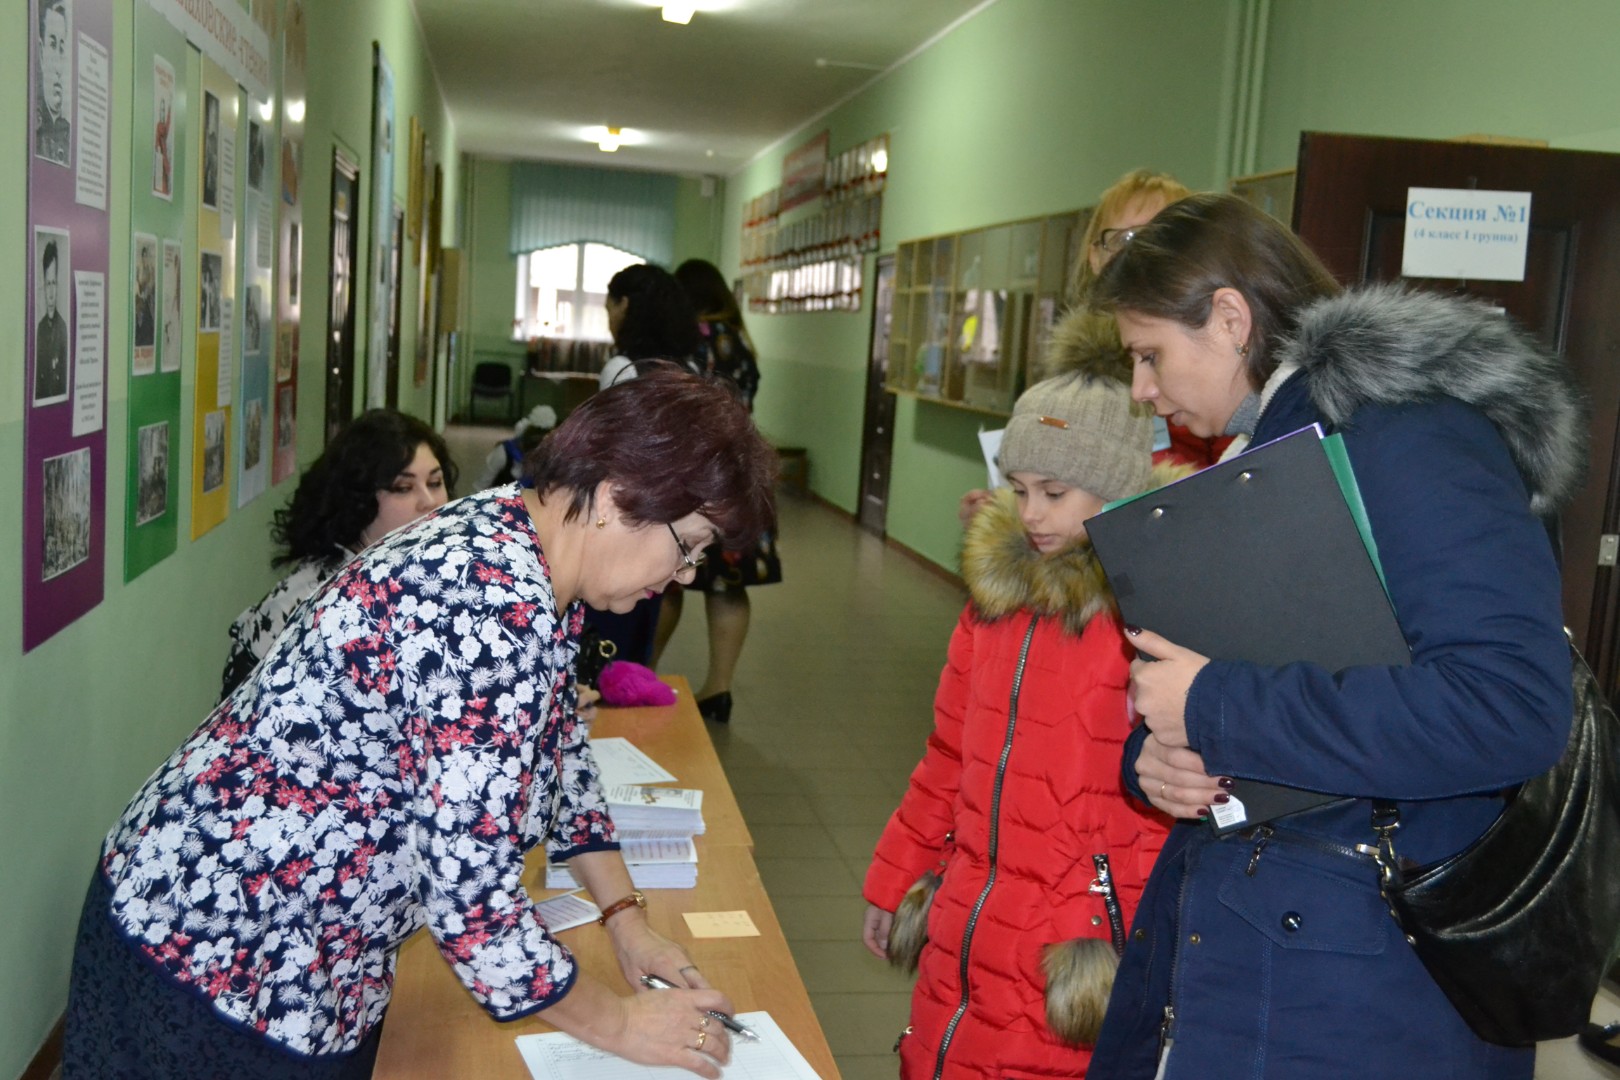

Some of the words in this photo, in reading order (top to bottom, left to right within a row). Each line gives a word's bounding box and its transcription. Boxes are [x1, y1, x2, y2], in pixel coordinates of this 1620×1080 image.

[1408, 201, 1487, 221] Секция
[1493, 204, 1526, 223] №1
[1413, 228, 1425, 239] (4
[1428, 230, 1460, 240] класс
[1472, 232, 1518, 244] группа)
